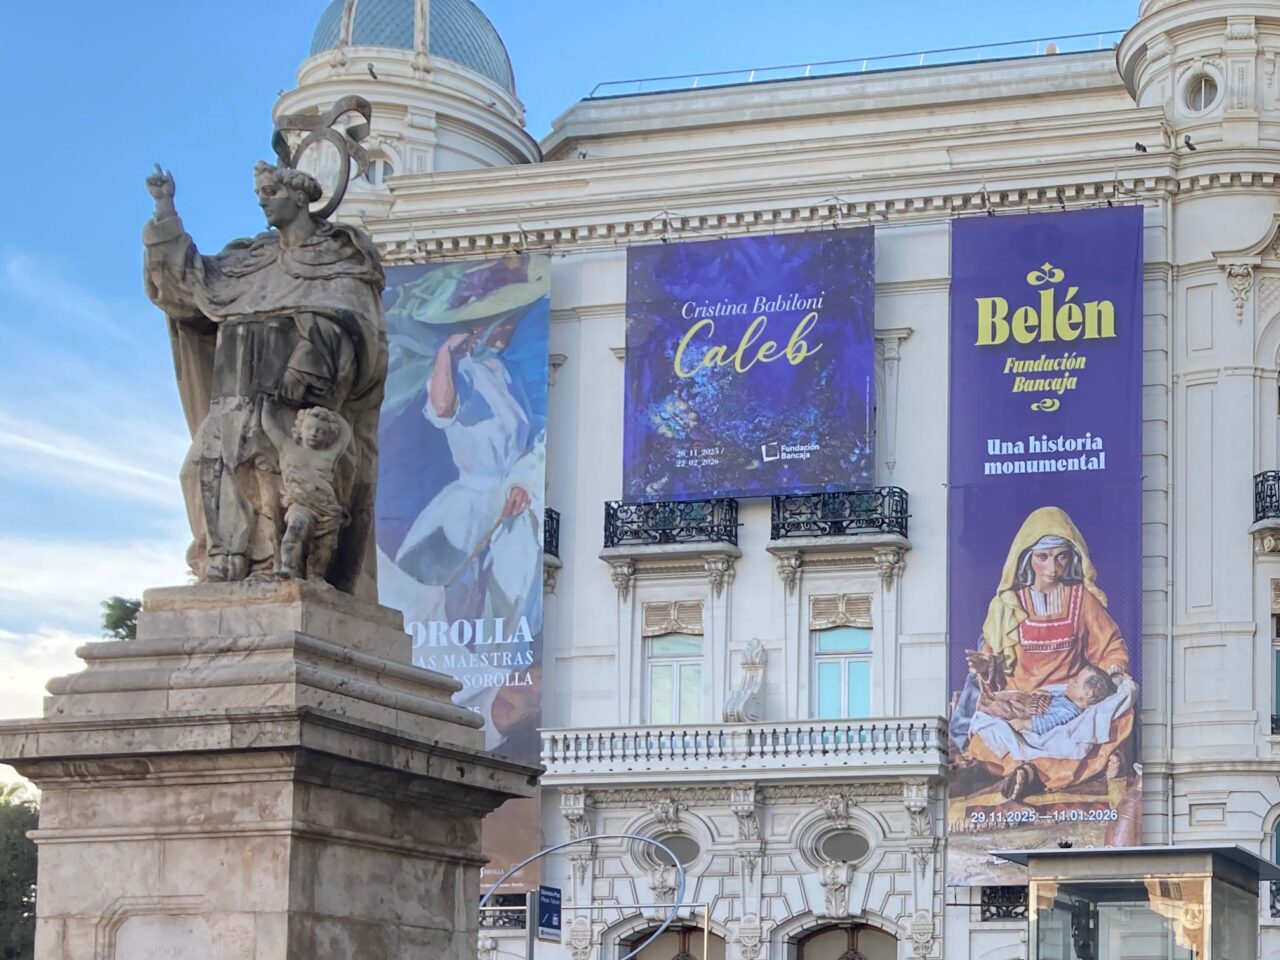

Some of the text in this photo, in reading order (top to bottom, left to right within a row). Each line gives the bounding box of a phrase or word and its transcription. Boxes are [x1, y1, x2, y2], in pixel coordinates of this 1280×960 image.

[681, 291, 824, 319] Cristina Babiloni
[974, 286, 1117, 346] Belén
[673, 311, 823, 379] Caleb
[1003, 352, 1086, 374] Fundación
[1012, 372, 1078, 395] Bancaja
[781, 443, 820, 453] Fundación
[987, 432, 1103, 455] Una historia
[781, 451, 811, 461] Bancaja
[984, 452, 1106, 475] monumental
[405, 615, 534, 648] OROLLA
[443, 650, 534, 669] MAESTRAS
[970, 810, 1036, 823] 29.11.2025
